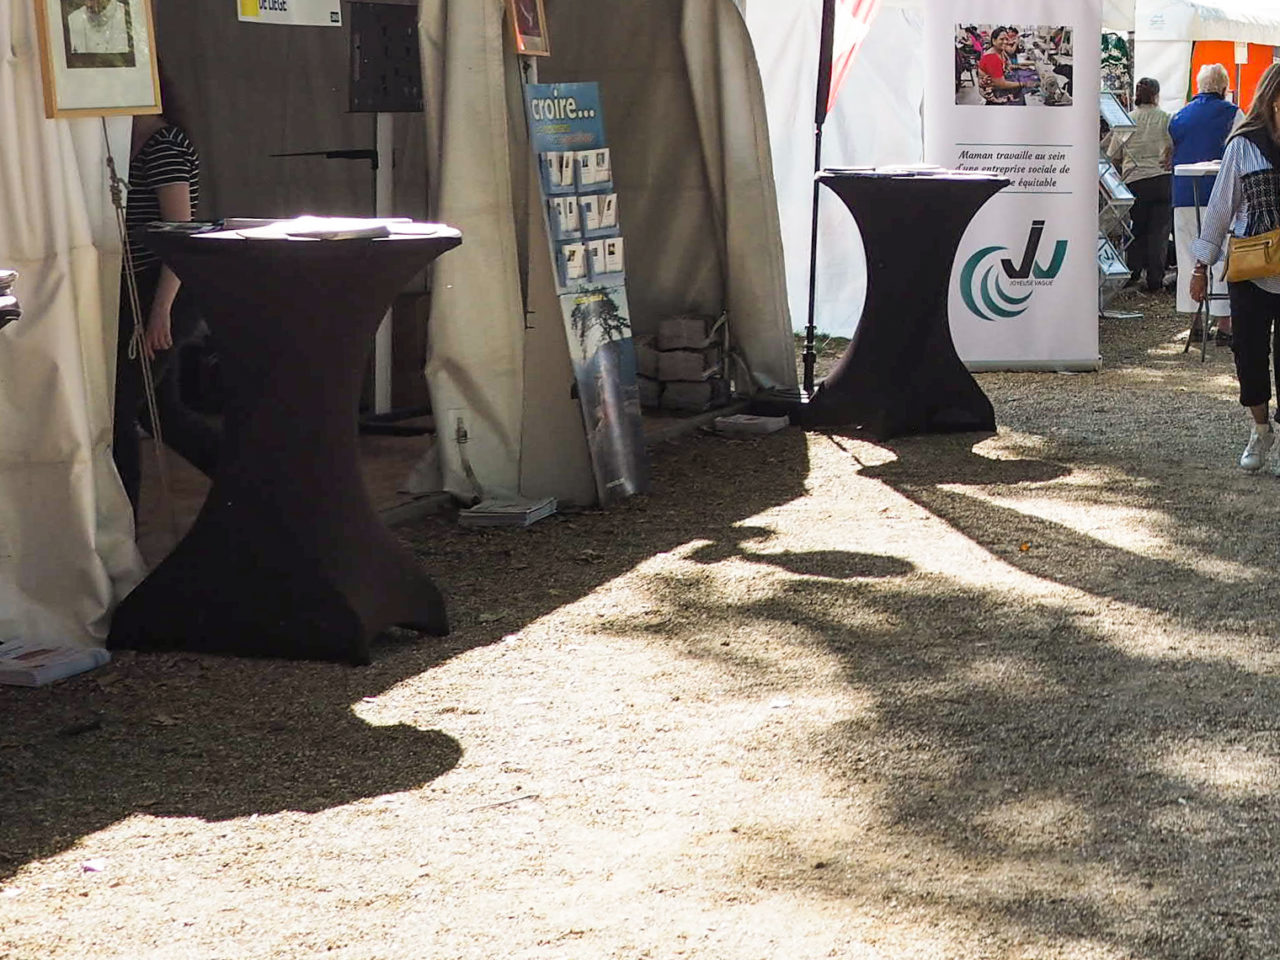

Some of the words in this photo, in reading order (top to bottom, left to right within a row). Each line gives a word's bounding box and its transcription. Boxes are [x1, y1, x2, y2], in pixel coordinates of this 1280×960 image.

[532, 89, 596, 120] croire...
[958, 150, 993, 160] Maman
[996, 150, 1033, 161] travaille
[1034, 152, 1046, 160] au
[1047, 151, 1066, 161] sein
[981, 164, 1026, 176] entreprise
[1027, 164, 1057, 174] sociale
[1059, 164, 1071, 174] de
[1018, 177, 1057, 189] équitable
[1009, 279, 1034, 287] JOYEUSE
[1034, 279, 1054, 287] VAGUE
